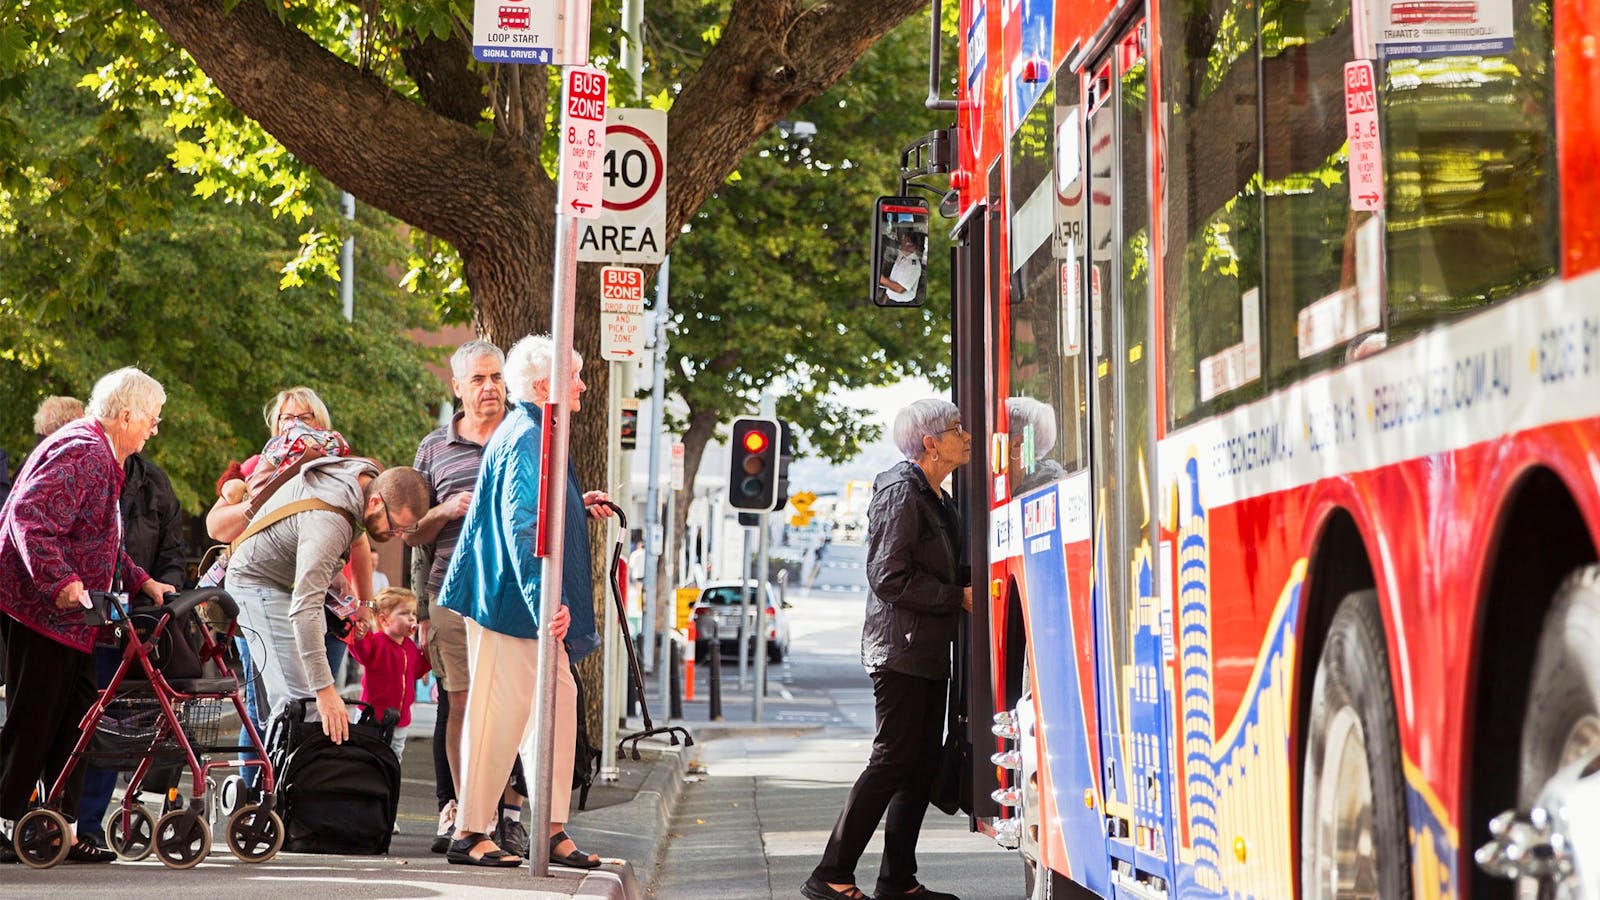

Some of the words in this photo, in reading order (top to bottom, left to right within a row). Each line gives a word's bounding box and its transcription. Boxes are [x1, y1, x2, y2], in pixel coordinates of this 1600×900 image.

[487, 33, 510, 43] LOOP
[512, 34, 540, 44] START
[483, 48, 510, 58] SIGNAL
[511, 50, 538, 59] DRIVER
[574, 74, 601, 96] BUS
[569, 97, 604, 120] ZONE
[572, 147, 585, 158] DROP
[579, 160, 589, 170] AND
[603, 149, 648, 188] 40
[573, 170, 585, 179] PICK
[576, 181, 589, 192] ZONE
[579, 225, 658, 253] AREA
[608, 271, 637, 285] BUS
[605, 285, 640, 299] ZONE
[605, 302, 623, 312] DROP
[627, 304, 640, 312] OFF
[615, 315, 630, 323] AND
[608, 325, 624, 333] PICK
[627, 326, 637, 334] UP
[614, 334, 632, 343] ZONE
